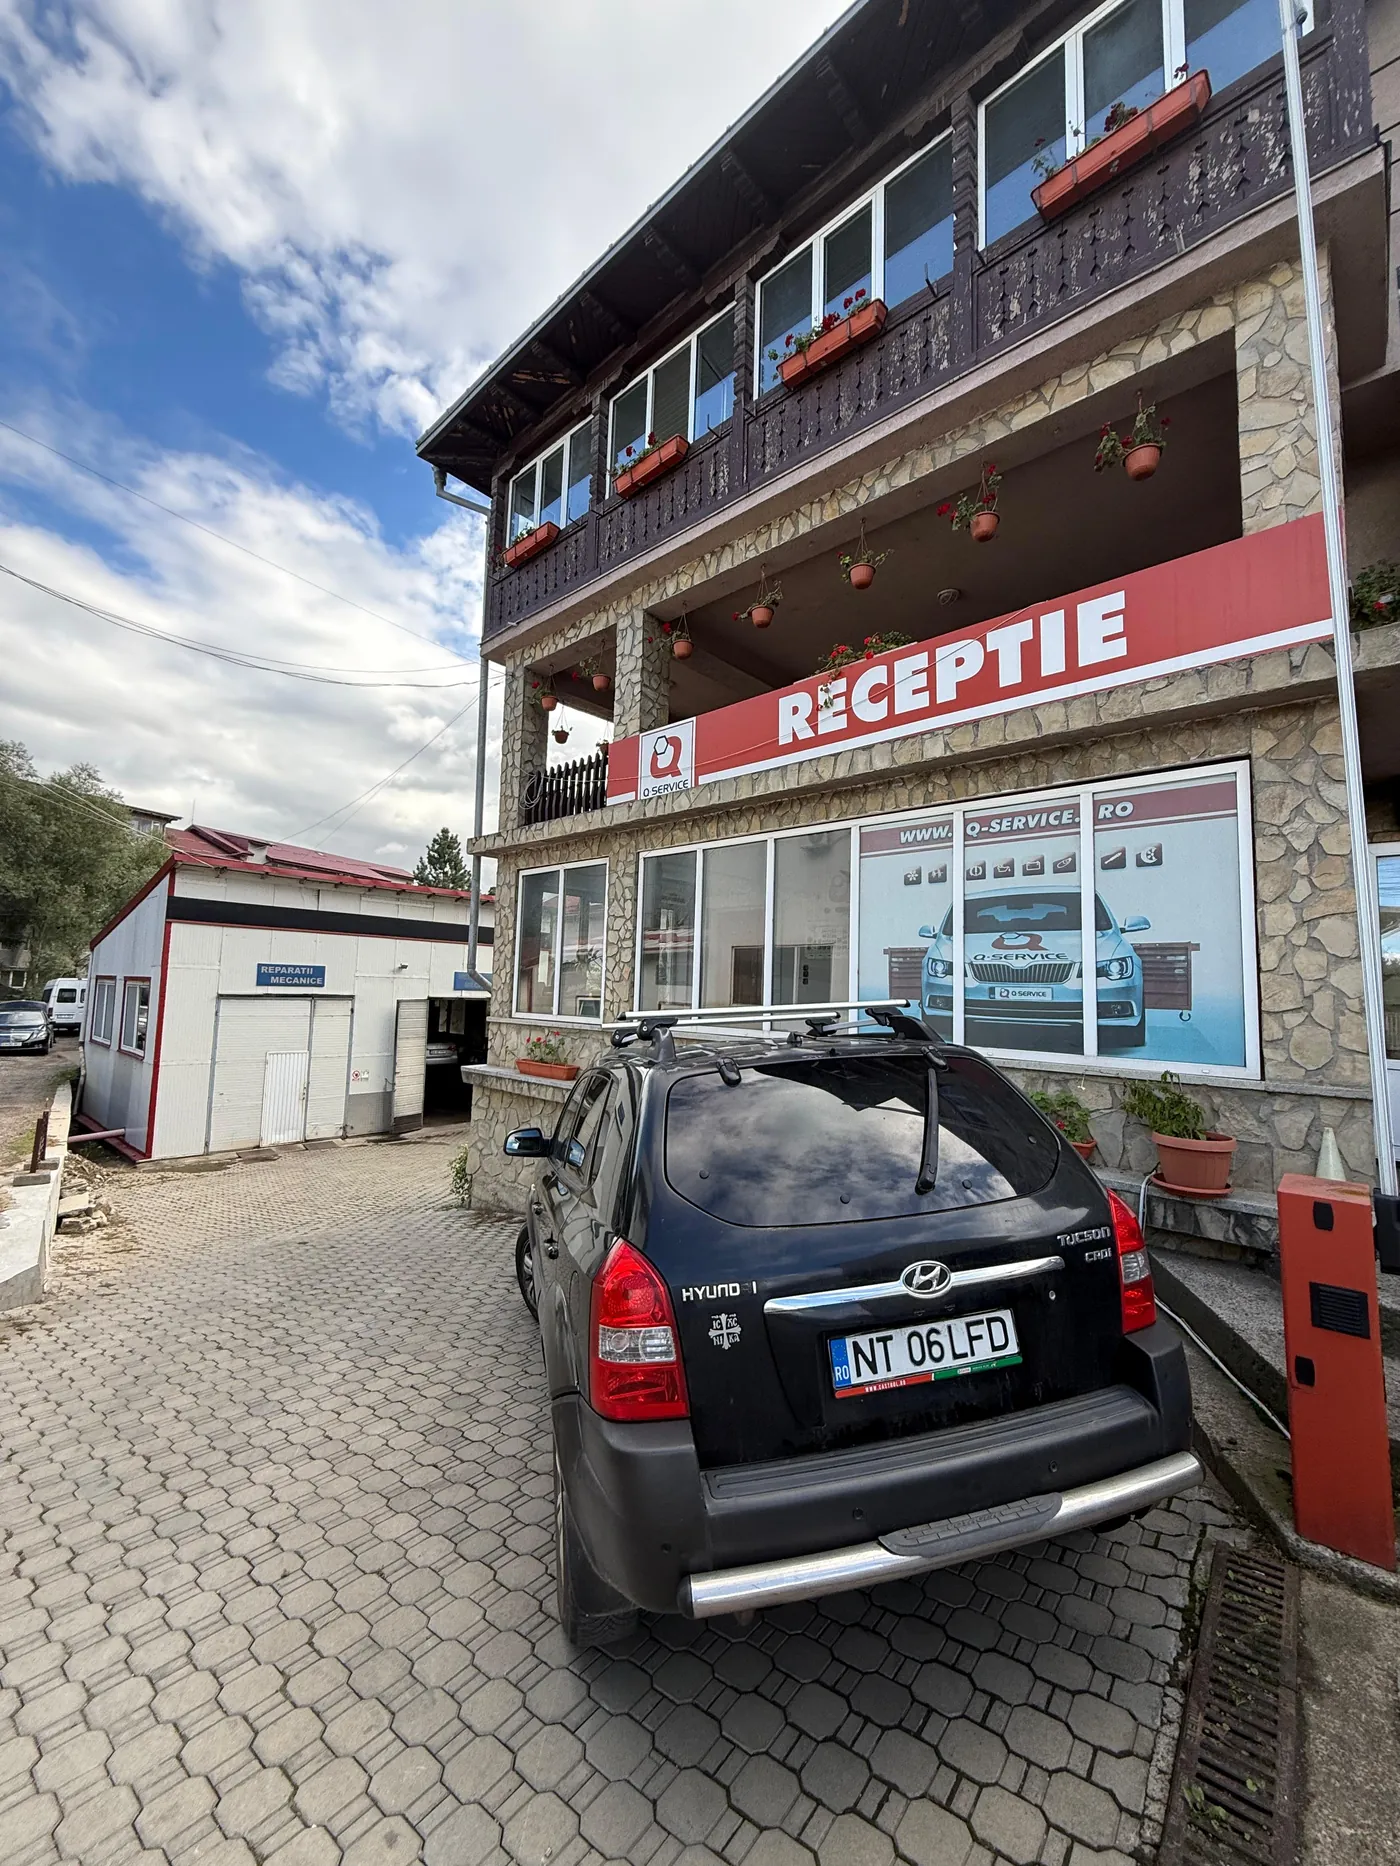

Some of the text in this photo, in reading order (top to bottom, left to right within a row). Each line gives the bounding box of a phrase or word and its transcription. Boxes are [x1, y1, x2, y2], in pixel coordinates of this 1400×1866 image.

[778, 590, 1127, 746] RECEPTIE
[261, 966, 313, 975] REPARATII
[270, 976, 323, 985] MECANICE
[1057, 1226, 1111, 1246] TUCSON
[852, 1335, 893, 1378] NT
[835, 1365, 849, 1381] RO
